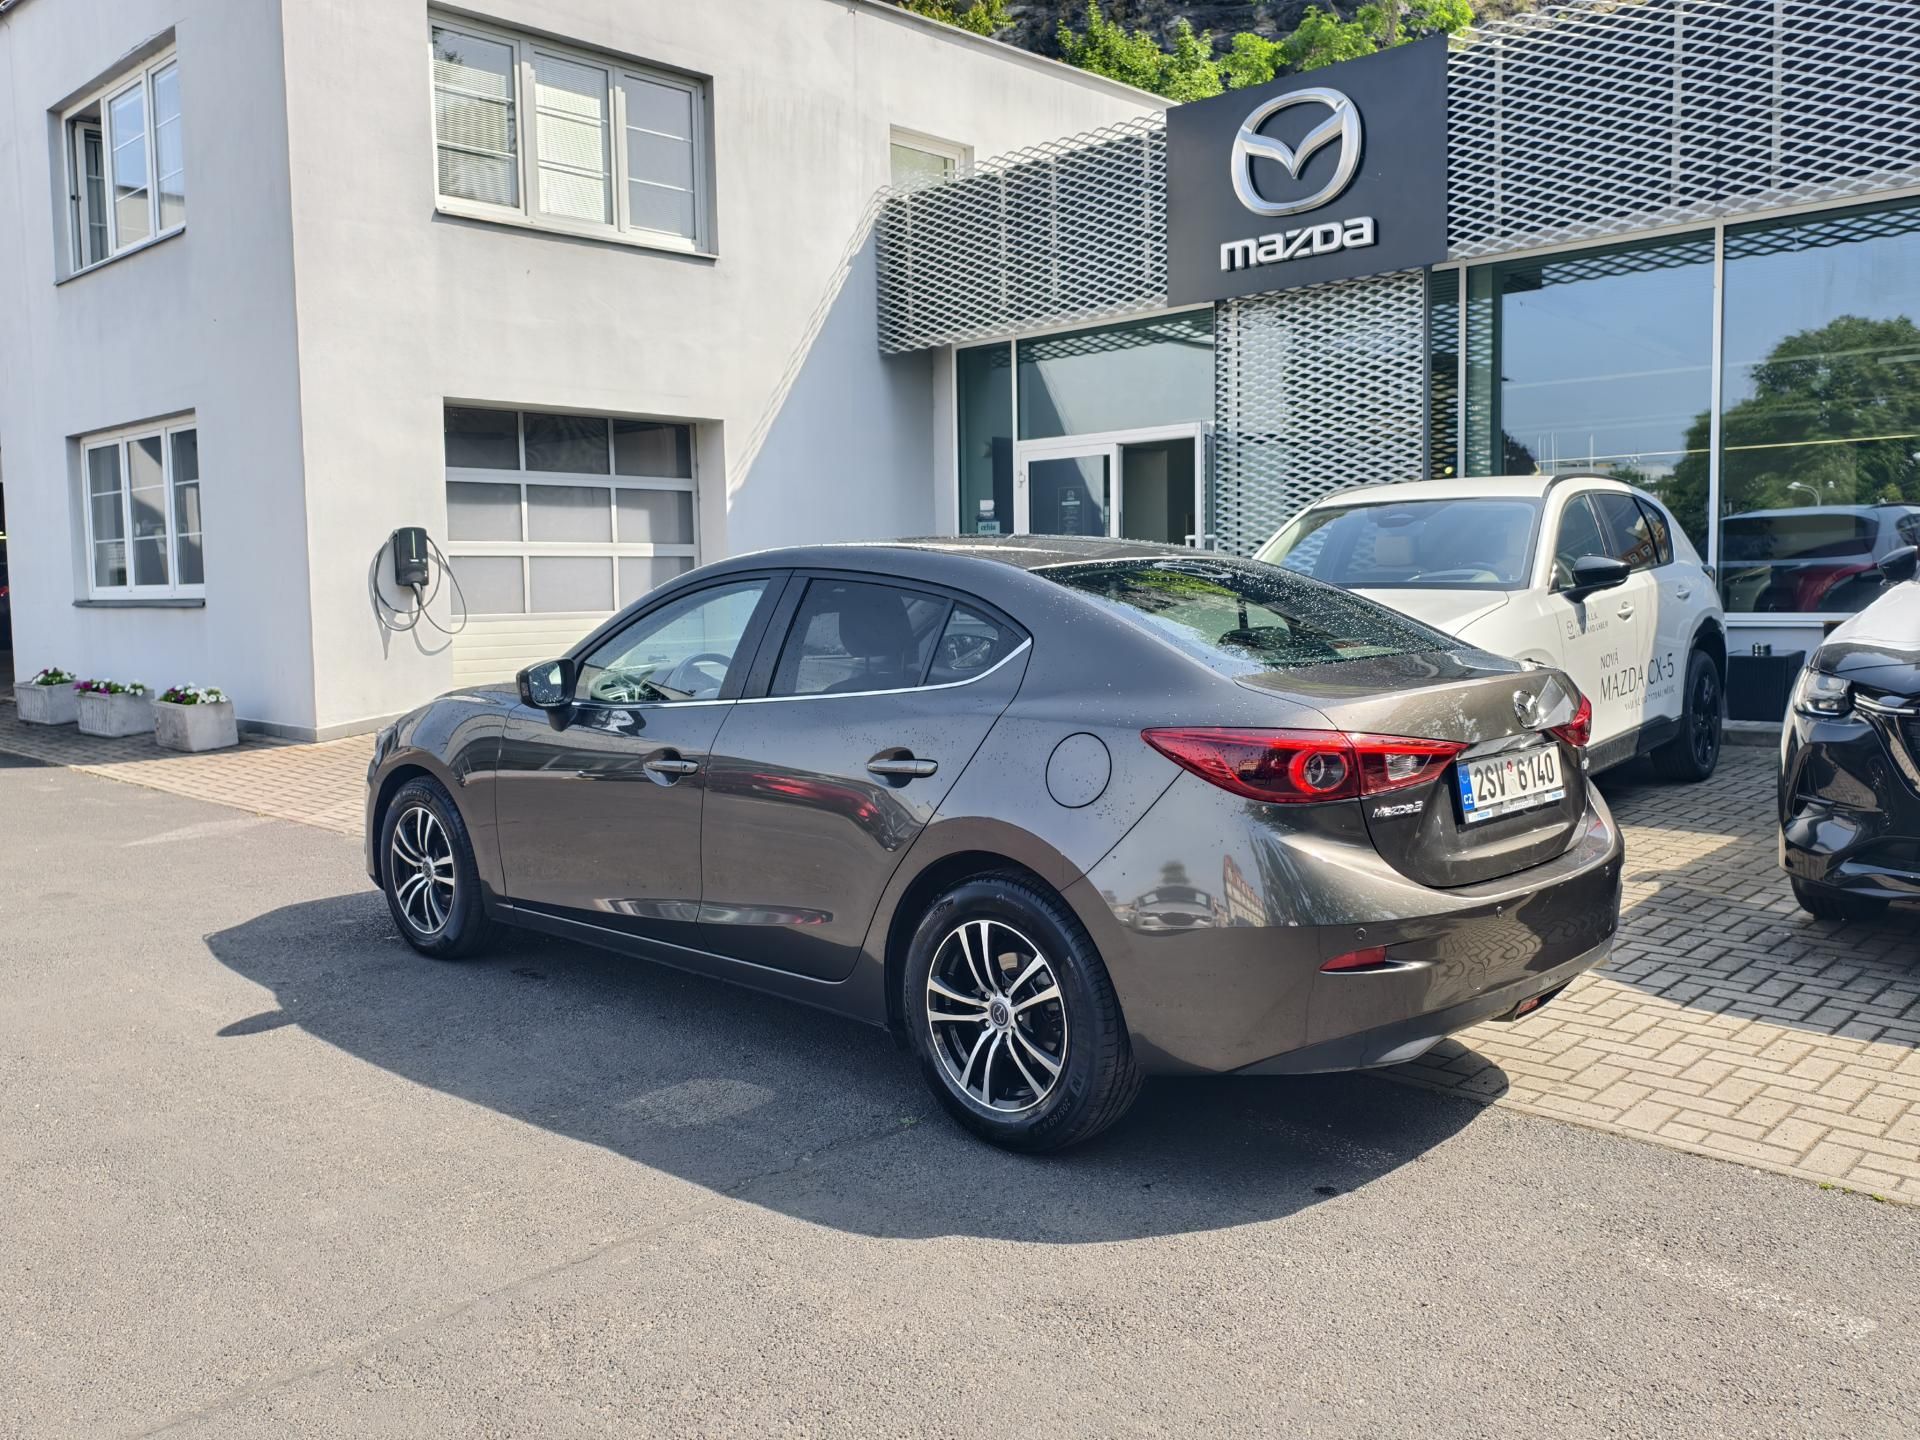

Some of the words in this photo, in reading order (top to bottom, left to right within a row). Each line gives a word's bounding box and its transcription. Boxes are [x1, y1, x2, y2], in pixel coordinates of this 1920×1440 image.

[1600, 664, 1645, 704] MAZDA
[1648, 652, 1675, 685] CX-5
[1464, 793, 1474, 805] CZ
[1474, 761, 1506, 802] 2SV
[1517, 752, 1555, 791] 6140
